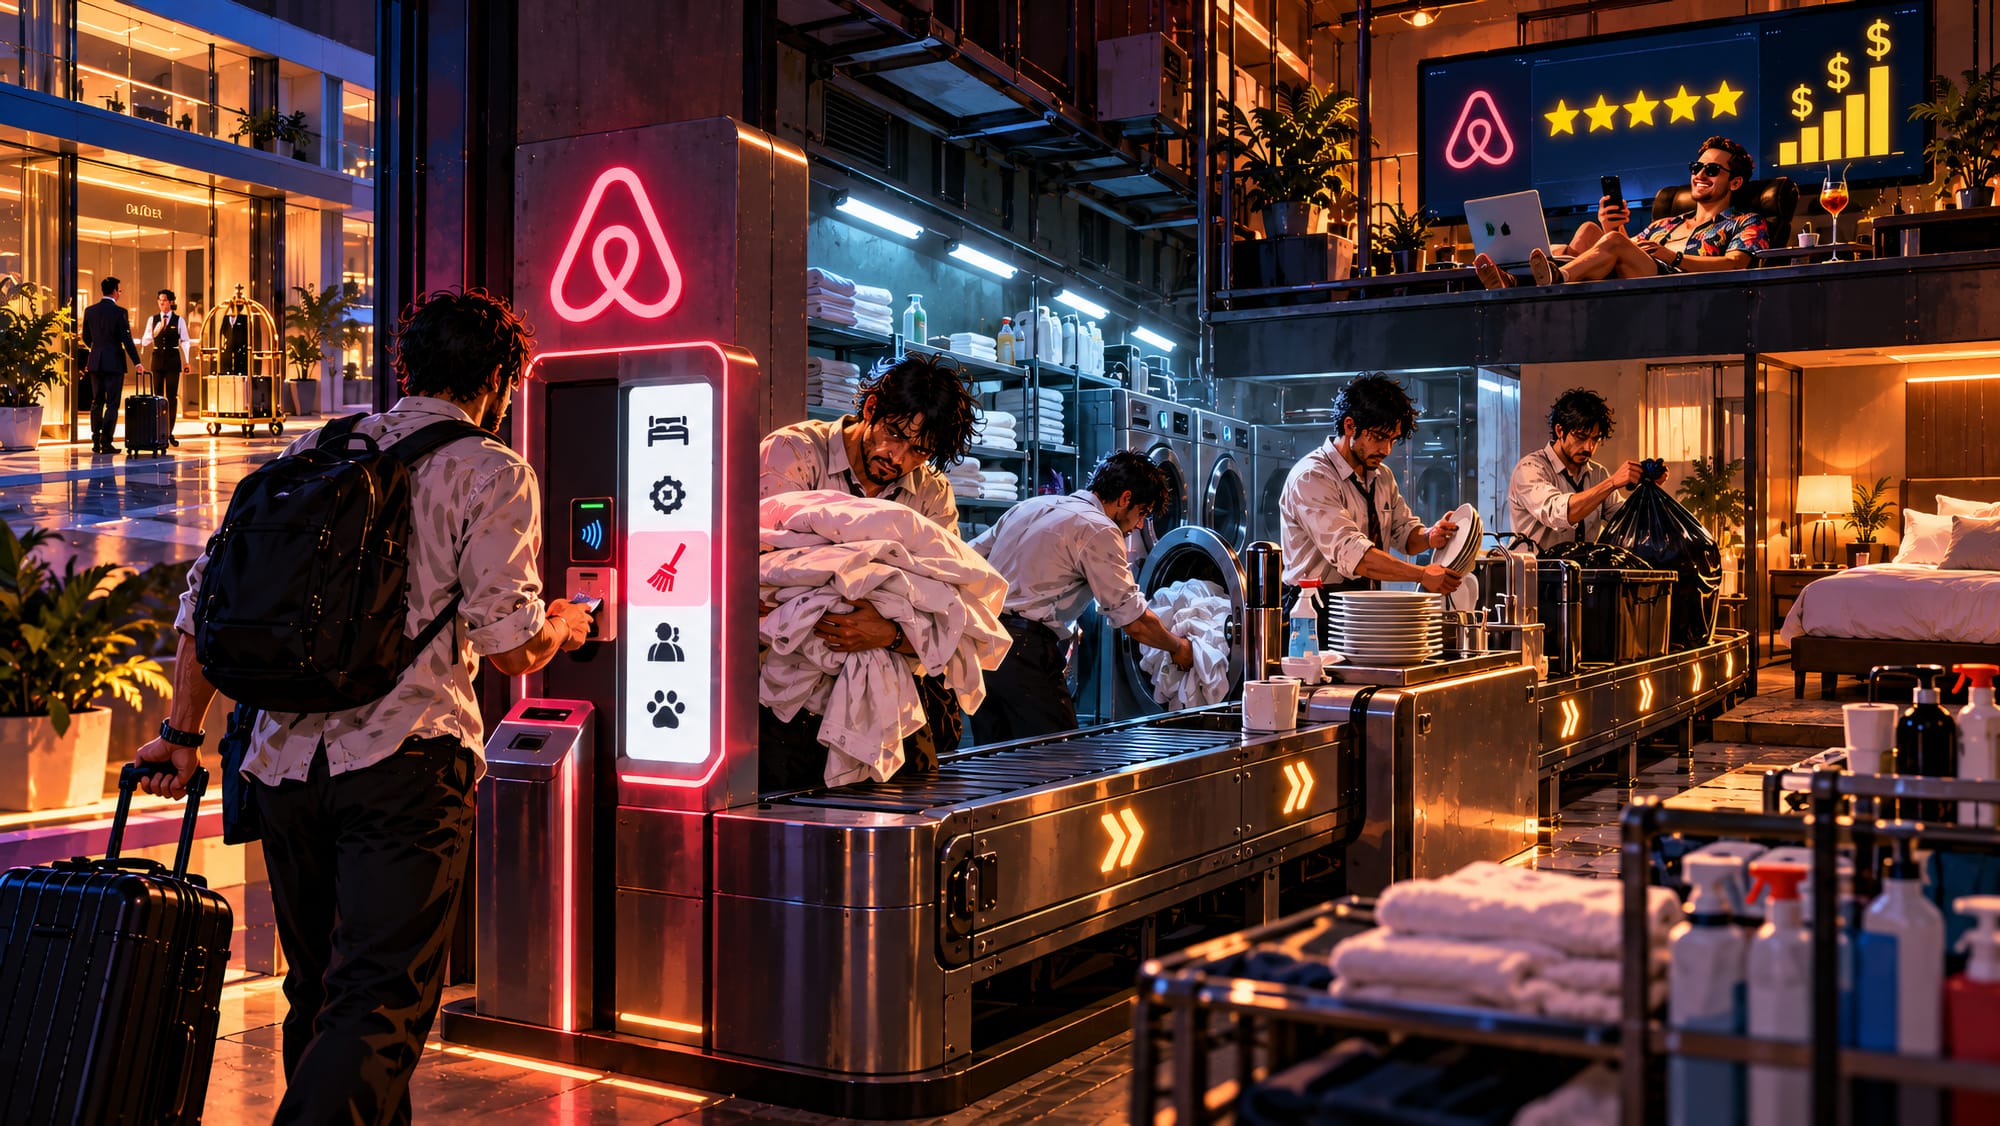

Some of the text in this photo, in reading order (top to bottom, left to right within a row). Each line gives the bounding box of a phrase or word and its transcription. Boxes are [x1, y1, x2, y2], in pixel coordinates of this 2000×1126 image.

[1866, 19, 1891, 61] $
[1827, 52, 1850, 93] $
[1791, 83, 1813, 121] $
